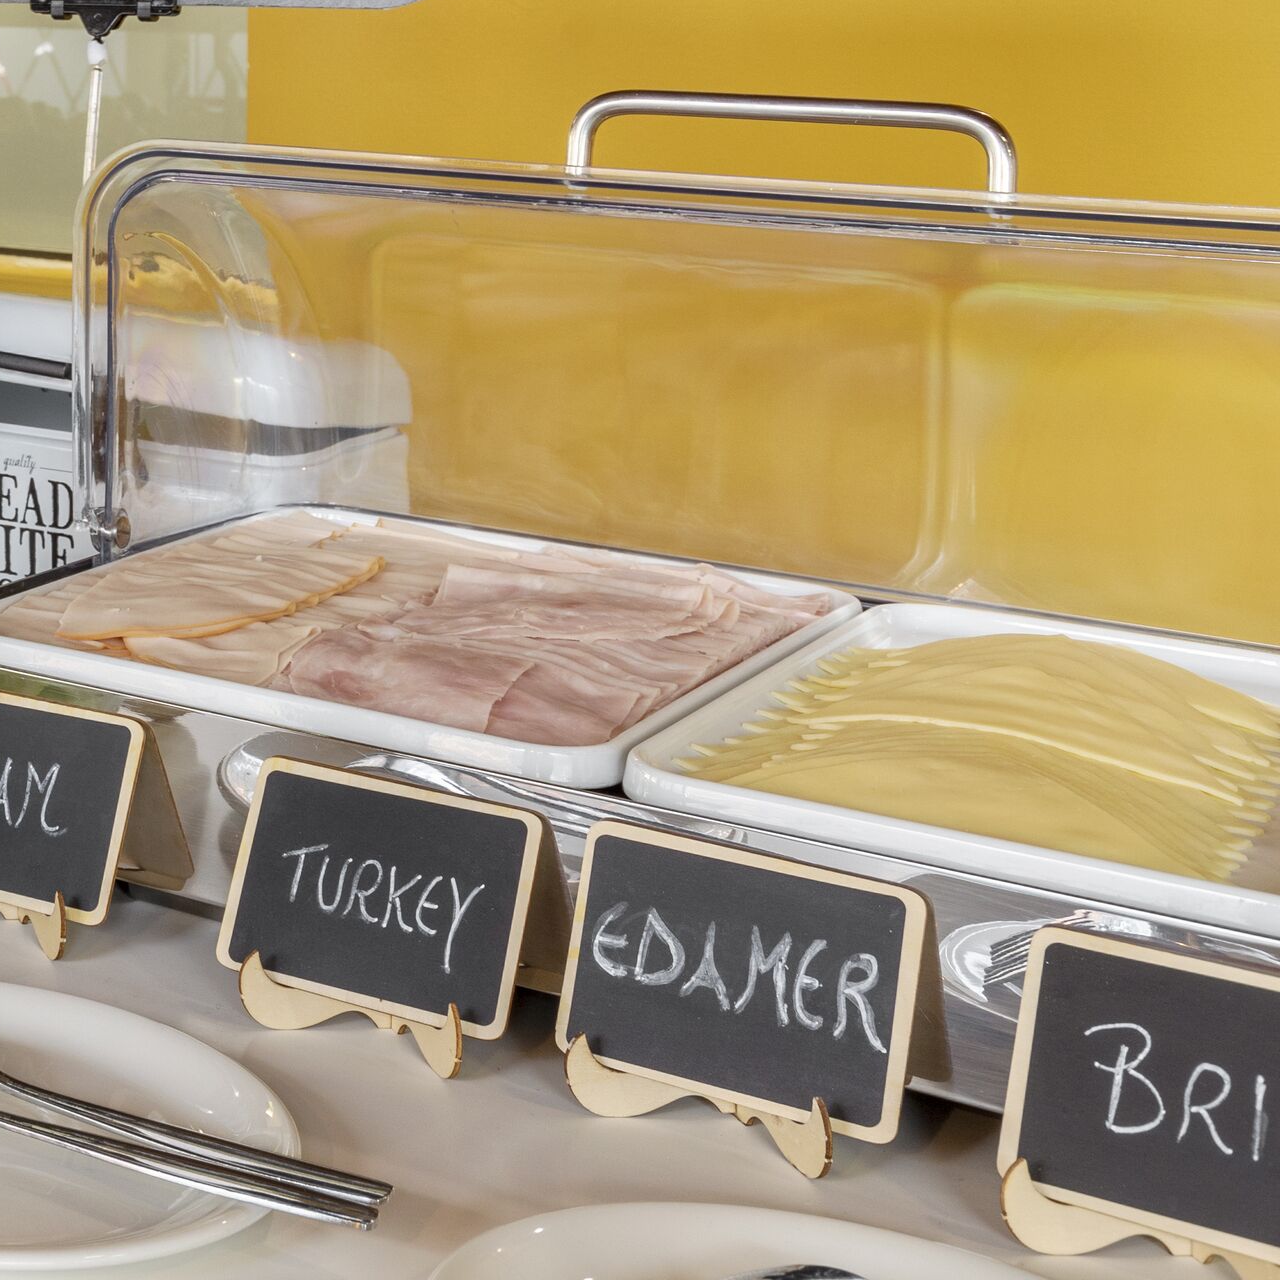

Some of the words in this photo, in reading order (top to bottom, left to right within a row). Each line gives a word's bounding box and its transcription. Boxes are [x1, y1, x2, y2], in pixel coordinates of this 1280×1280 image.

[3, 454, 36, 474] quality
[281, 843, 485, 975] TURKEY
[592, 901, 887, 1055] EDAMER
[1084, 1021, 1267, 1162] BRI
